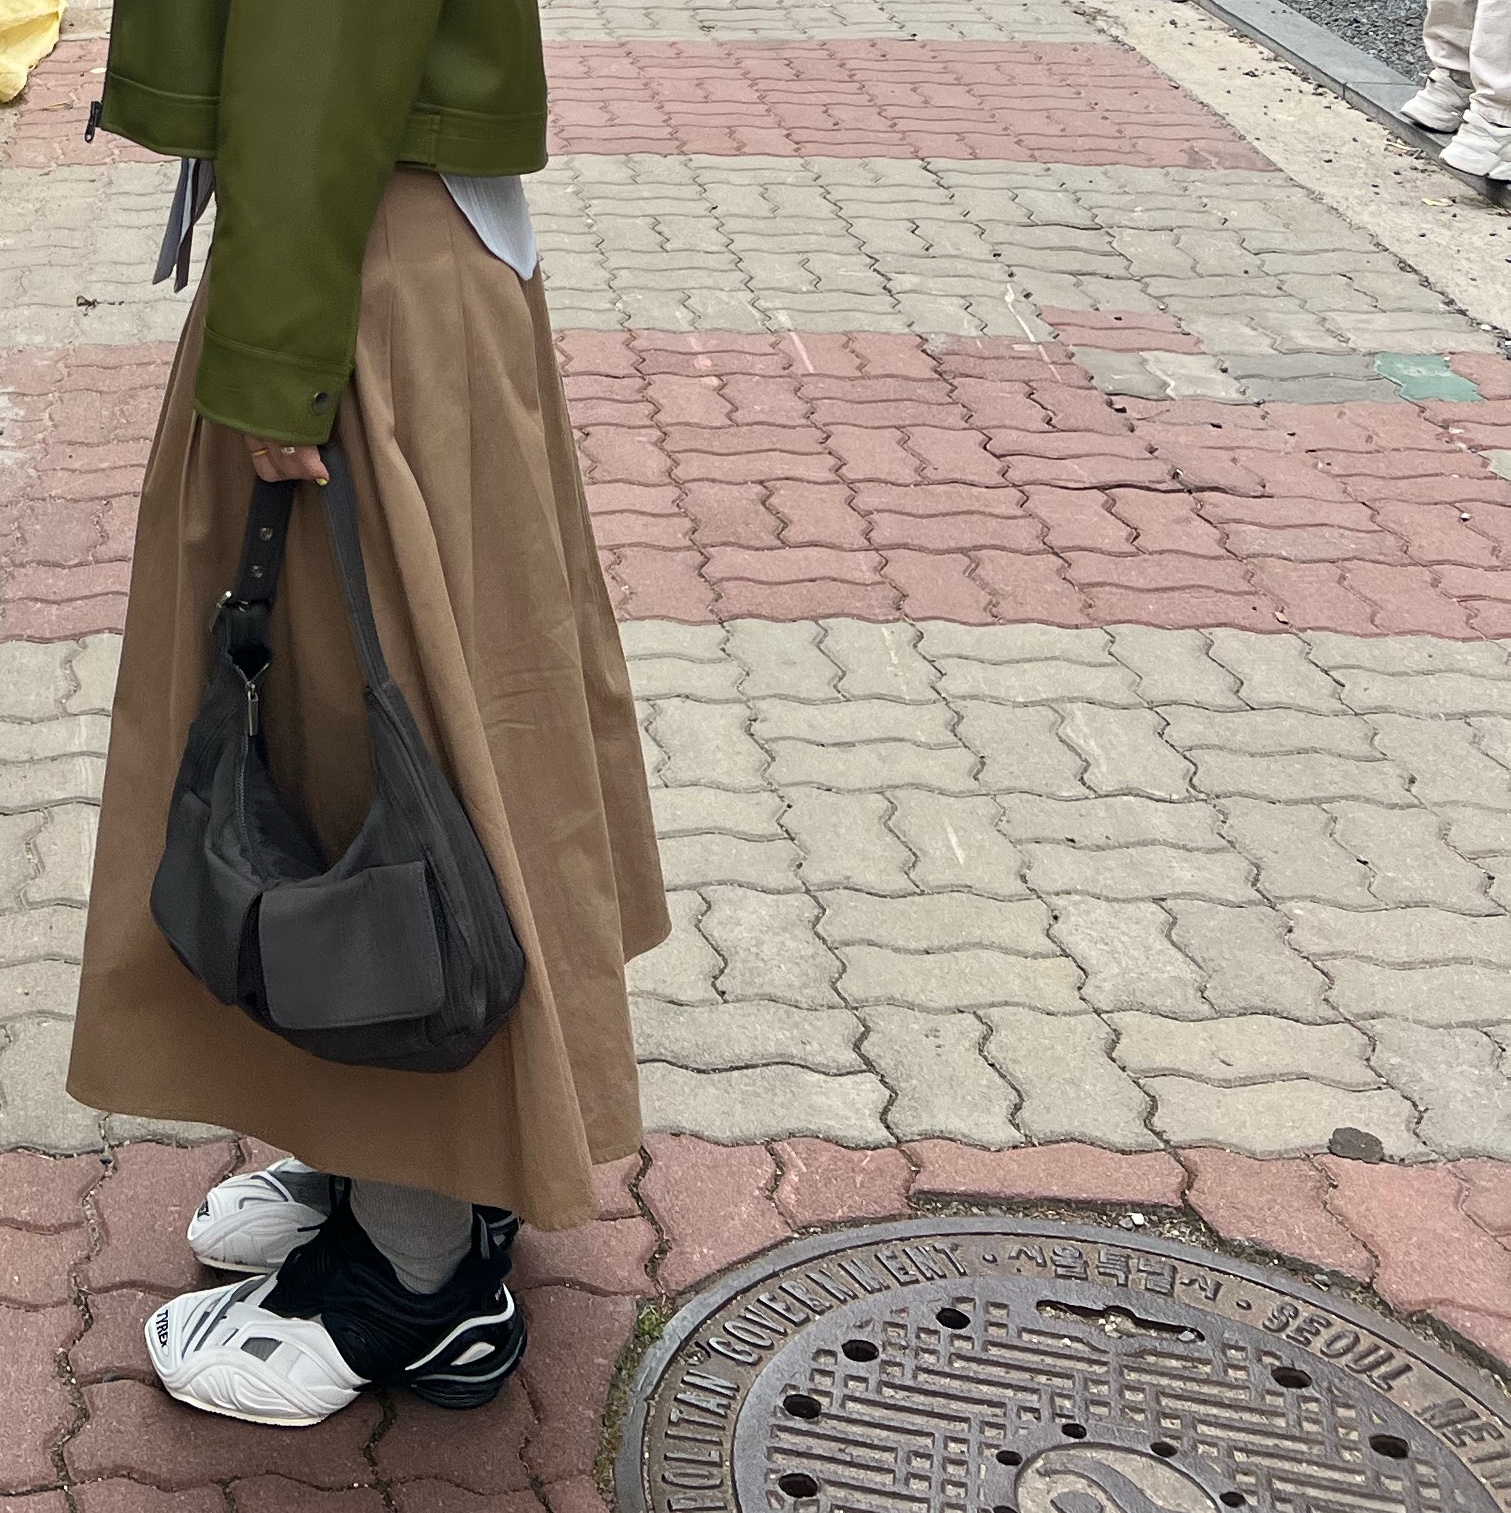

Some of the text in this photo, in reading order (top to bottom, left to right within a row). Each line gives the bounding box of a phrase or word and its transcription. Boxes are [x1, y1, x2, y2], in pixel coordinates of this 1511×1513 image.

[708, 1243, 970, 1366] GOVERNMENT
[1007, 1243, 1224, 1303] 서울특별시
[155, 1308, 169, 1349] TYREX
[1262, 1301, 1414, 1392] SEOUL
